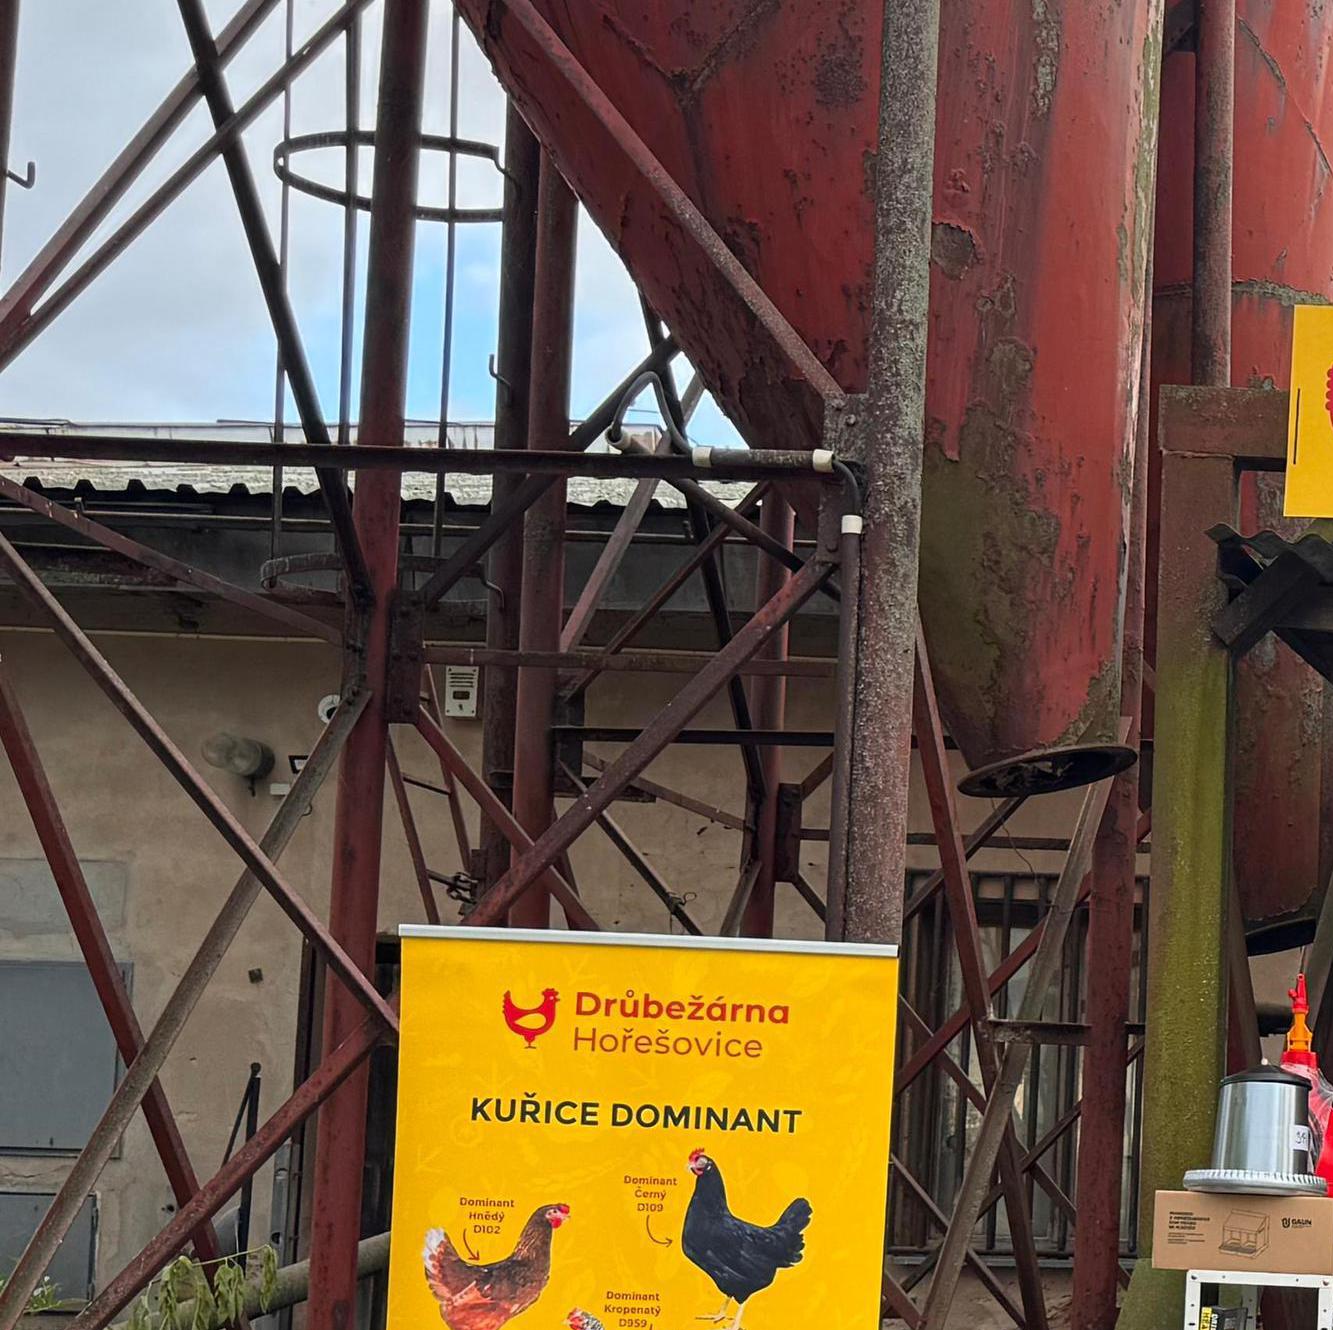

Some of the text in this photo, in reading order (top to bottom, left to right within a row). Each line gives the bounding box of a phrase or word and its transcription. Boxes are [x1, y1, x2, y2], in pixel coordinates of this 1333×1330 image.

[576, 990, 789, 1024] Drůbežárna
[574, 1027, 762, 1058] Hořešovice
[472, 1092, 802, 1133] KUŘICE DOMINANT
[624, 1175, 677, 1186] Dominant
[635, 1186, 666, 1201] Černý
[460, 1197, 514, 1207] Dominant
[637, 1203, 663, 1212] D109
[469, 1211, 504, 1223] Hnědý
[474, 1225, 500, 1234] D102
[606, 1291, 659, 1301] Dominant
[604, 1304, 661, 1317] Kropenatý
[619, 1319, 647, 1328] D959
